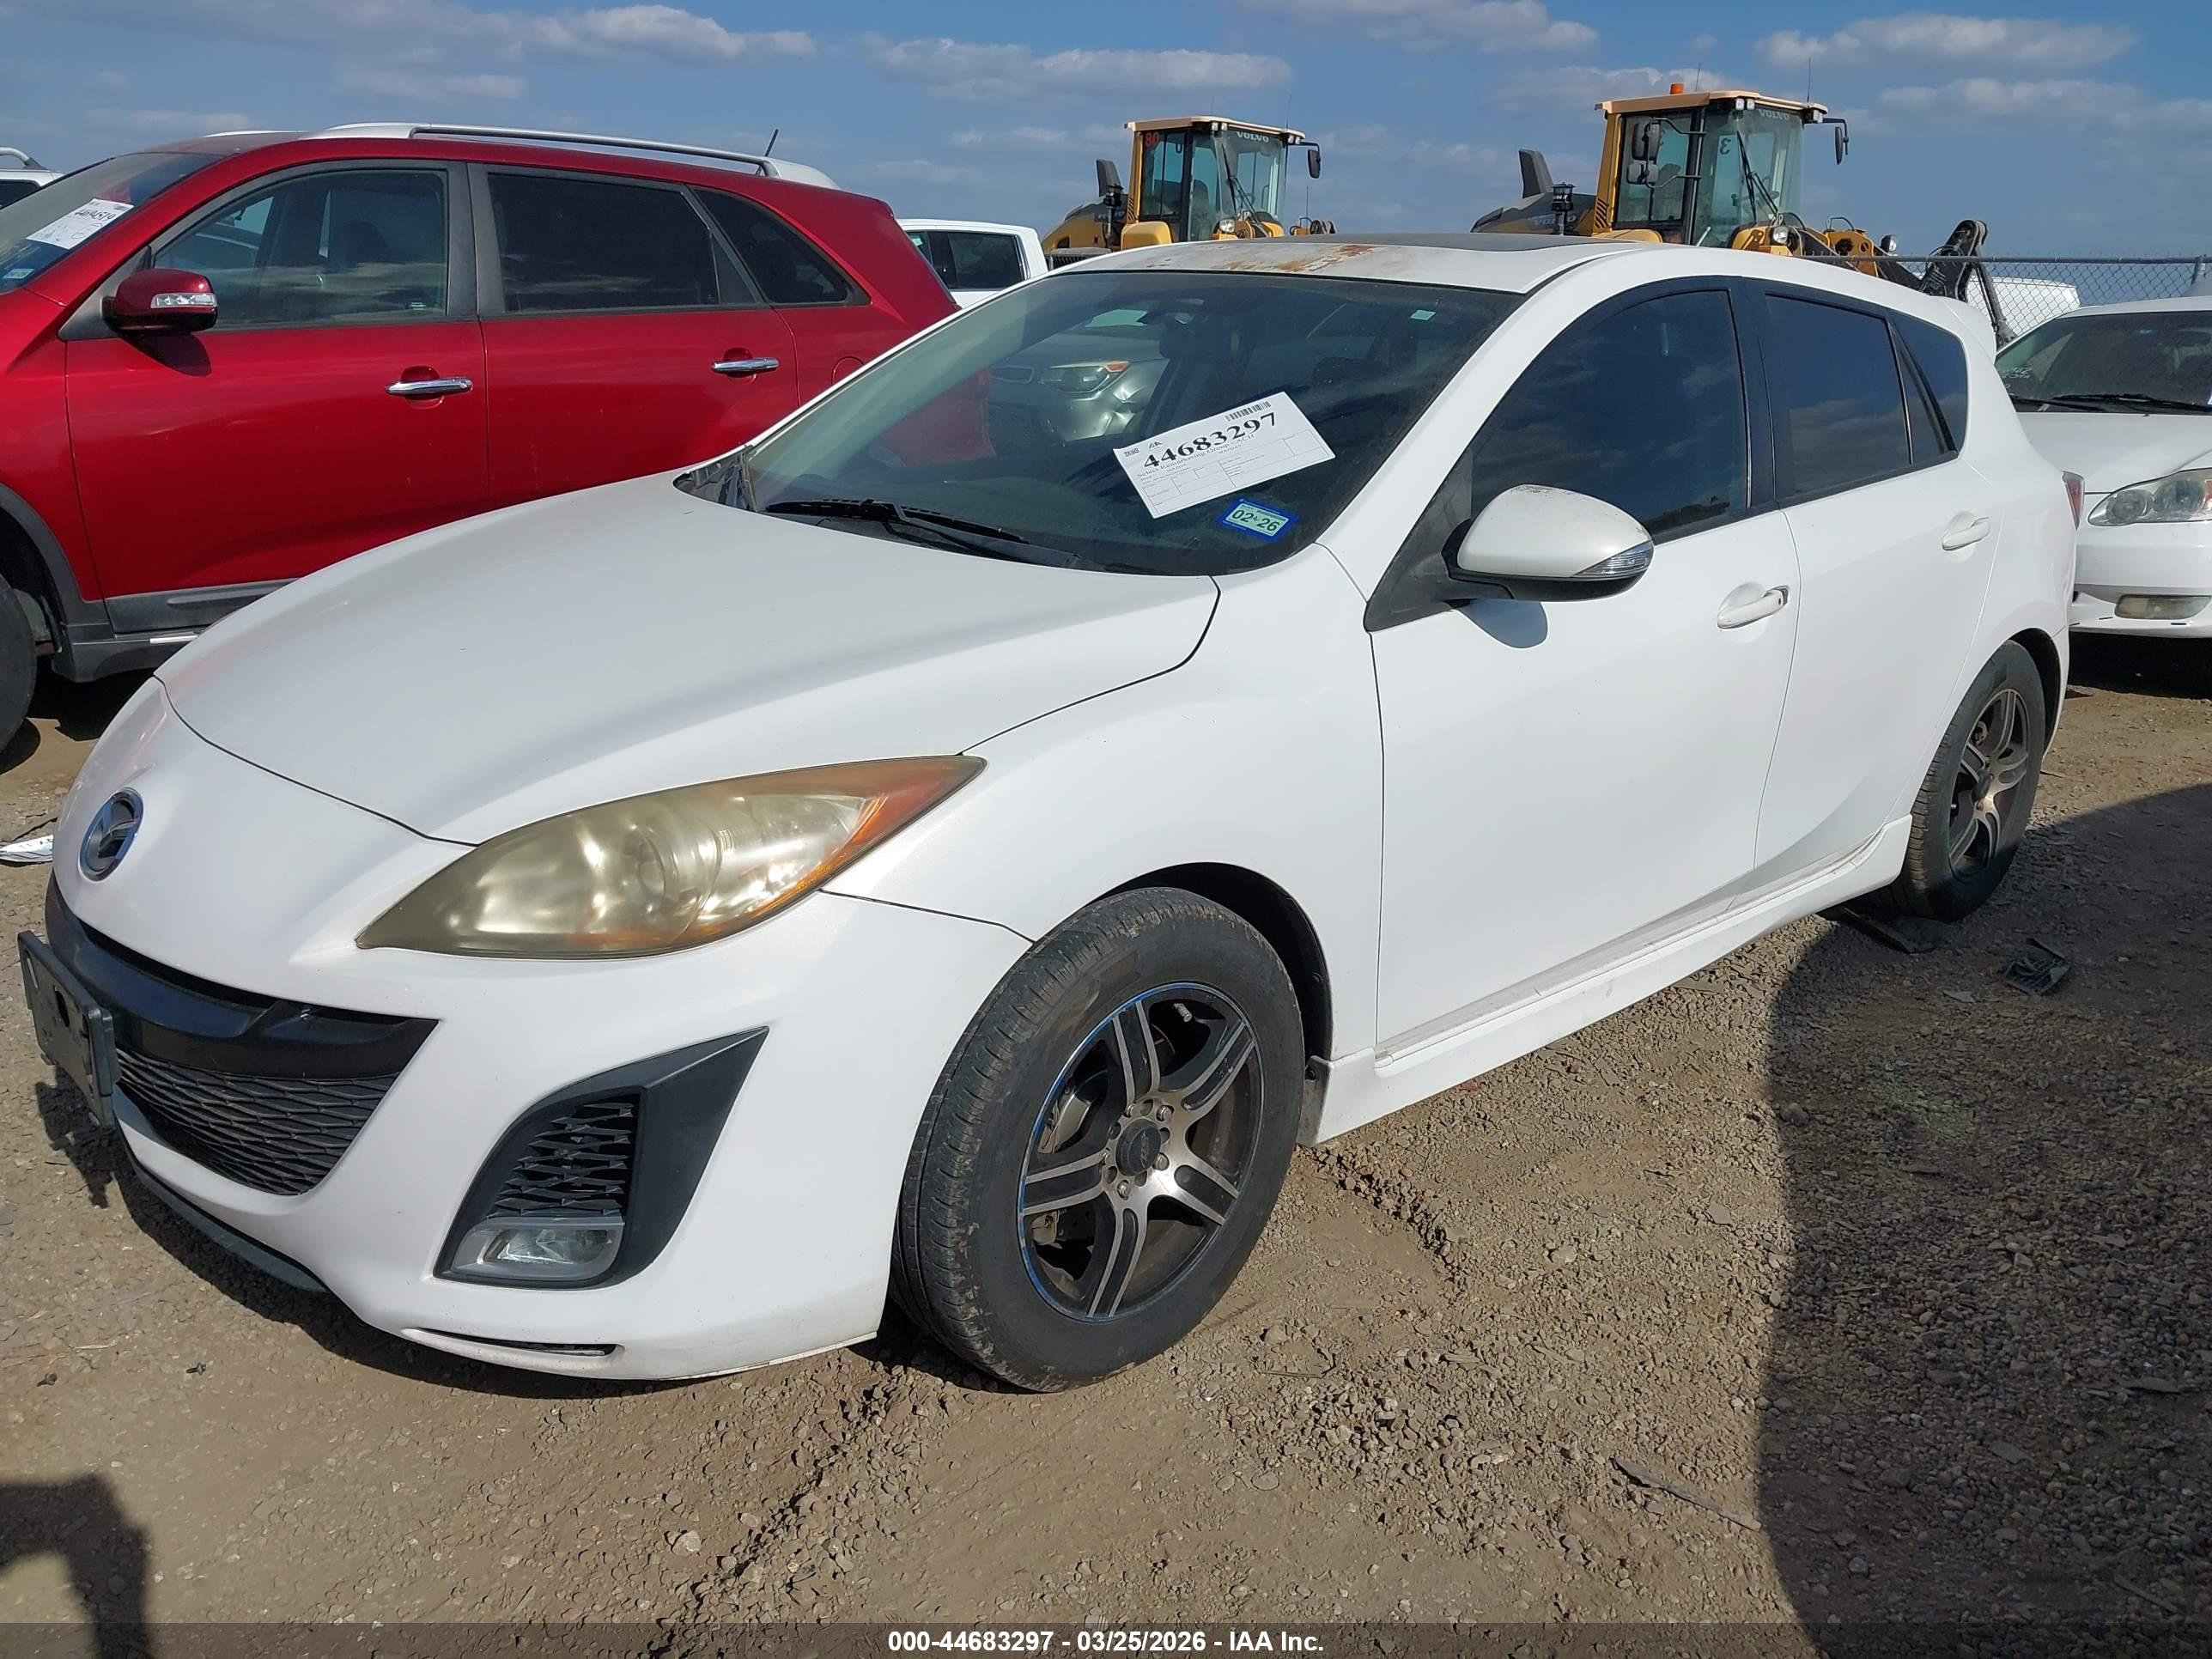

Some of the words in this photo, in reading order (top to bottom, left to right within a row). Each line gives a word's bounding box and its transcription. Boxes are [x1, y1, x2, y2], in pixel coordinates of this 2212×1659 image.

[1759, 108, 1790, 121] VOLVO
[1145, 132, 1159, 147] 80
[1236, 131, 1269, 143] VOLVO
[1144, 412, 1275, 467] 44683297
[1137, 467, 1160, 477] Select
[1160, 451, 1206, 470] Remarketing
[1232, 509, 1254, 522] 02
[1257, 518, 1279, 531] 26
